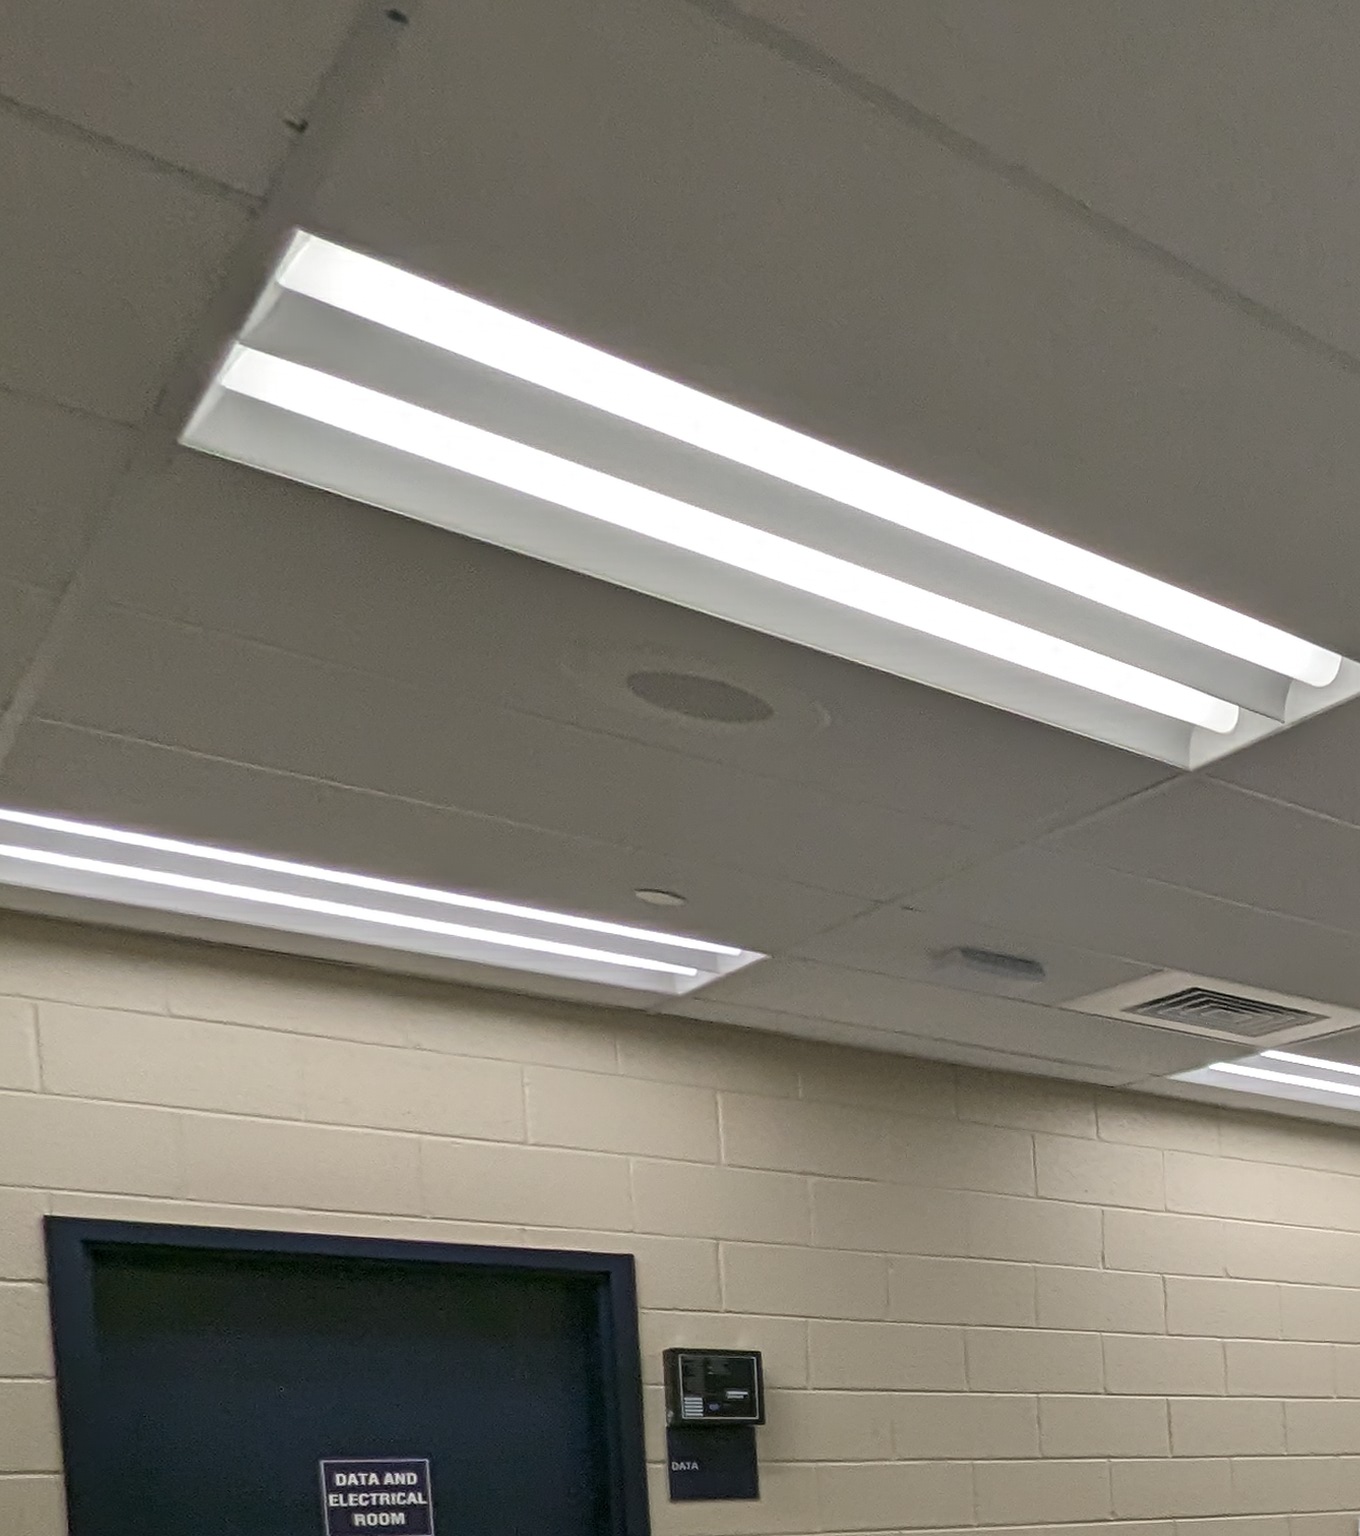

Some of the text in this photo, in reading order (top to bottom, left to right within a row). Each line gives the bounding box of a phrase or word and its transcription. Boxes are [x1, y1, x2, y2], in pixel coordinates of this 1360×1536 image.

[671, 1461, 699, 1471] DATA
[335, 1472, 418, 1486] DATA AND
[328, 1492, 428, 1507] ELECTRICAL
[353, 1512, 405, 1526] ROOM
